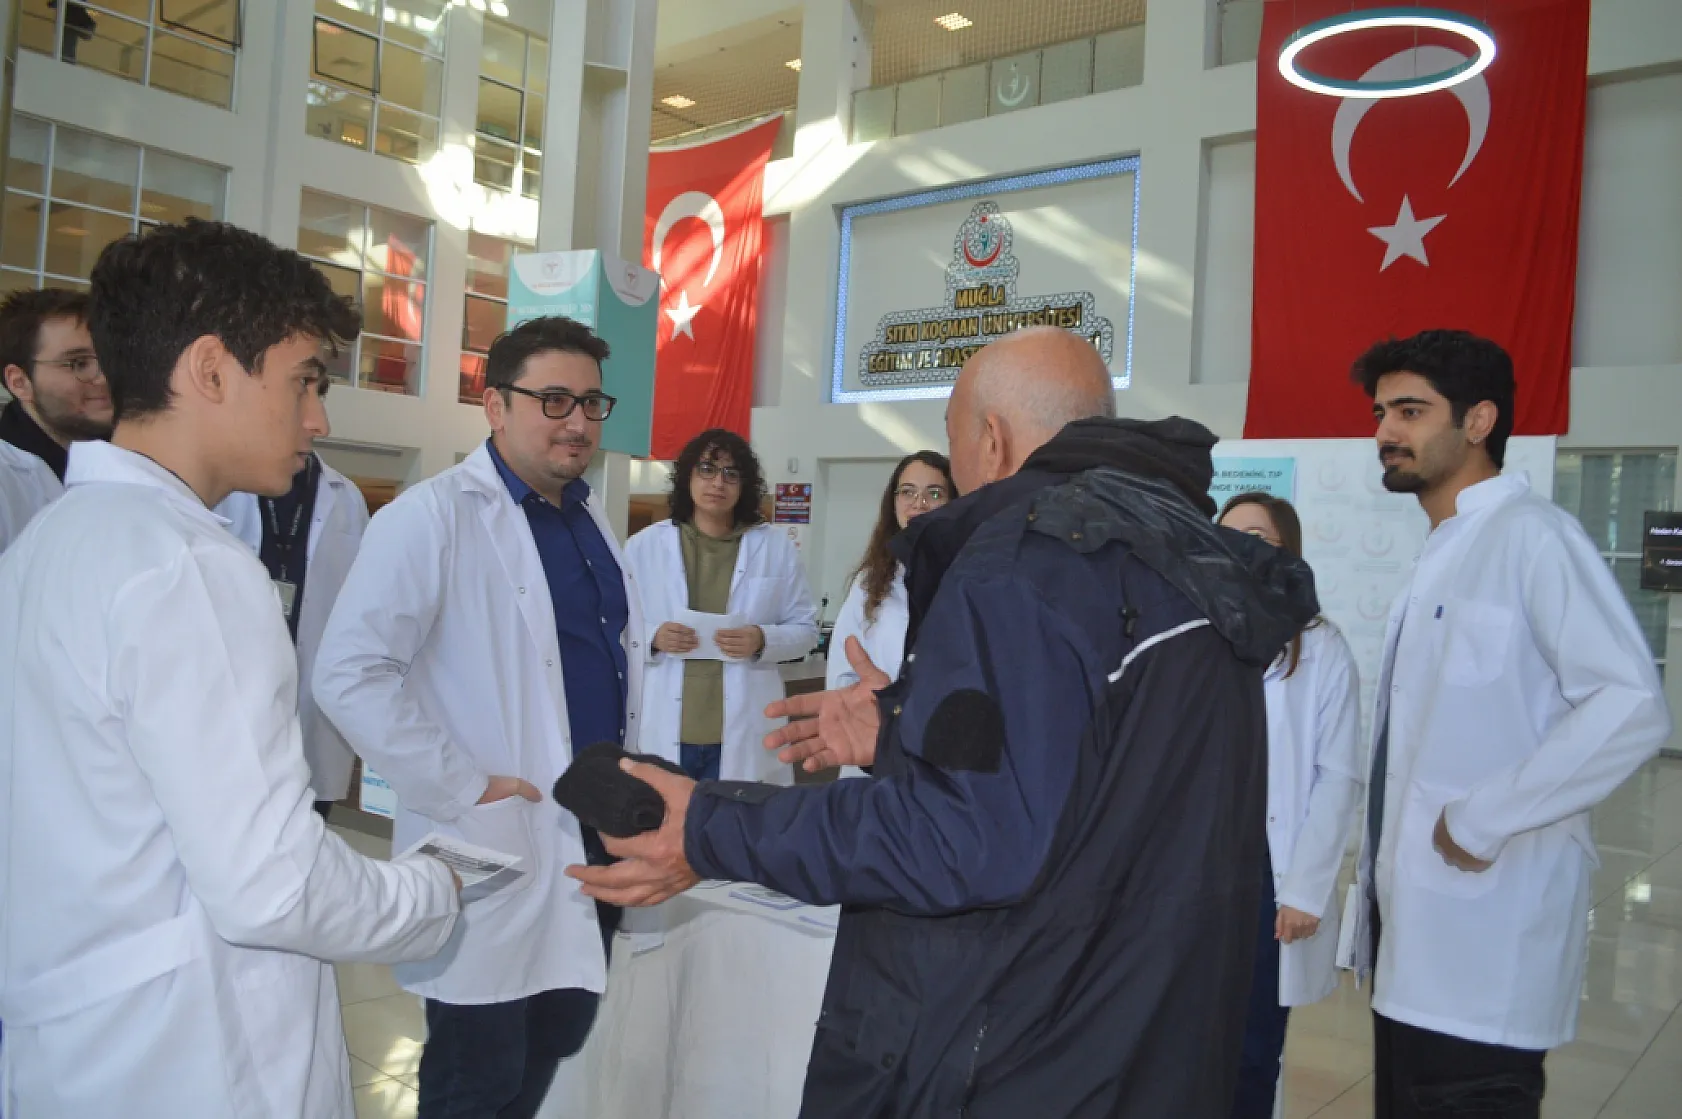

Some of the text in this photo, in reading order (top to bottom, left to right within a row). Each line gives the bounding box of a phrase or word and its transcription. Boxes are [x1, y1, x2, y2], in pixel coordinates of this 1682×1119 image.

[955, 283, 1005, 308] MUĞLA
[886, 322, 918, 344] SITKI
[921, 317, 979, 343] KOÇMAN
